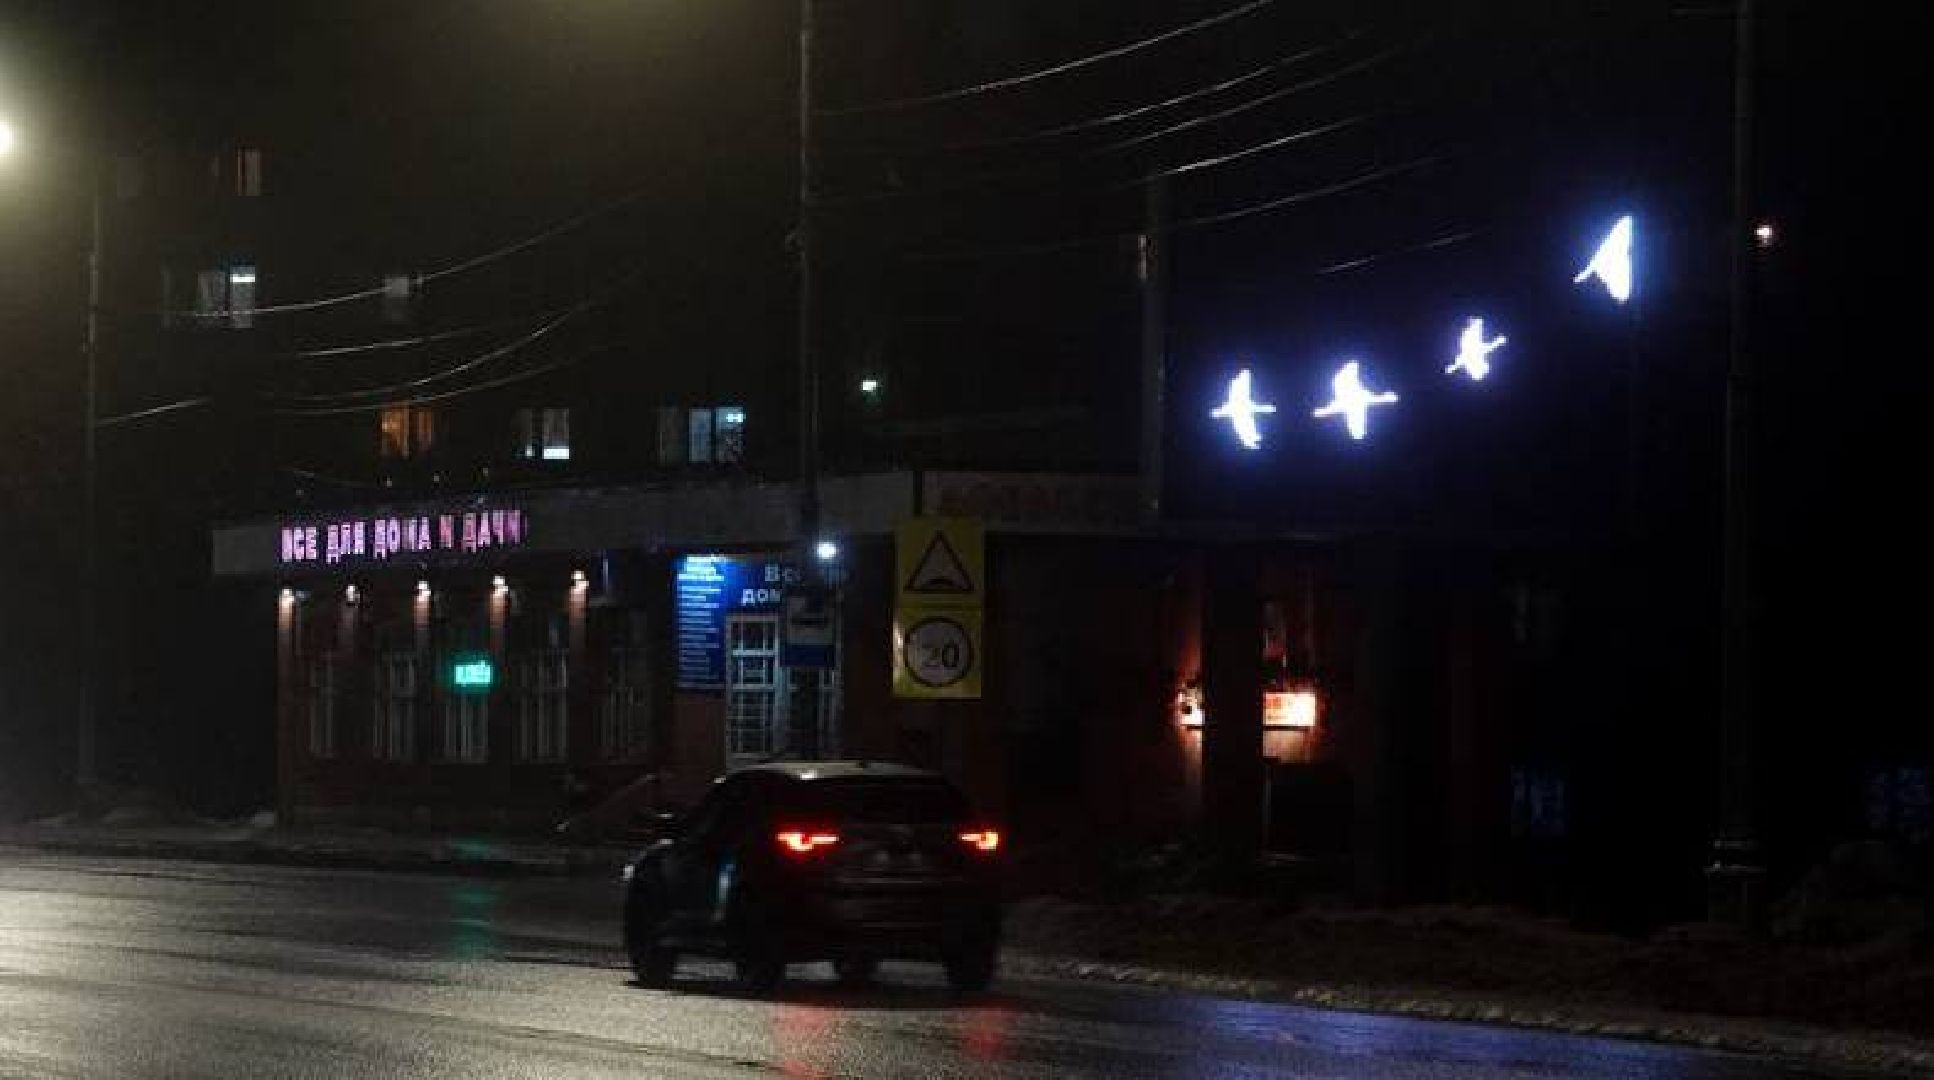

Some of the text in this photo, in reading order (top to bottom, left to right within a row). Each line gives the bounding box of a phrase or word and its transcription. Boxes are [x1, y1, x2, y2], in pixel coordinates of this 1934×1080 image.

[326, 522, 366, 564] ДЛЯ
[373, 516, 432, 559] ДОМА
[438, 514, 454, 548] И
[462, 509, 524, 553] ДАЧИ
[920, 642, 961, 669] 20
